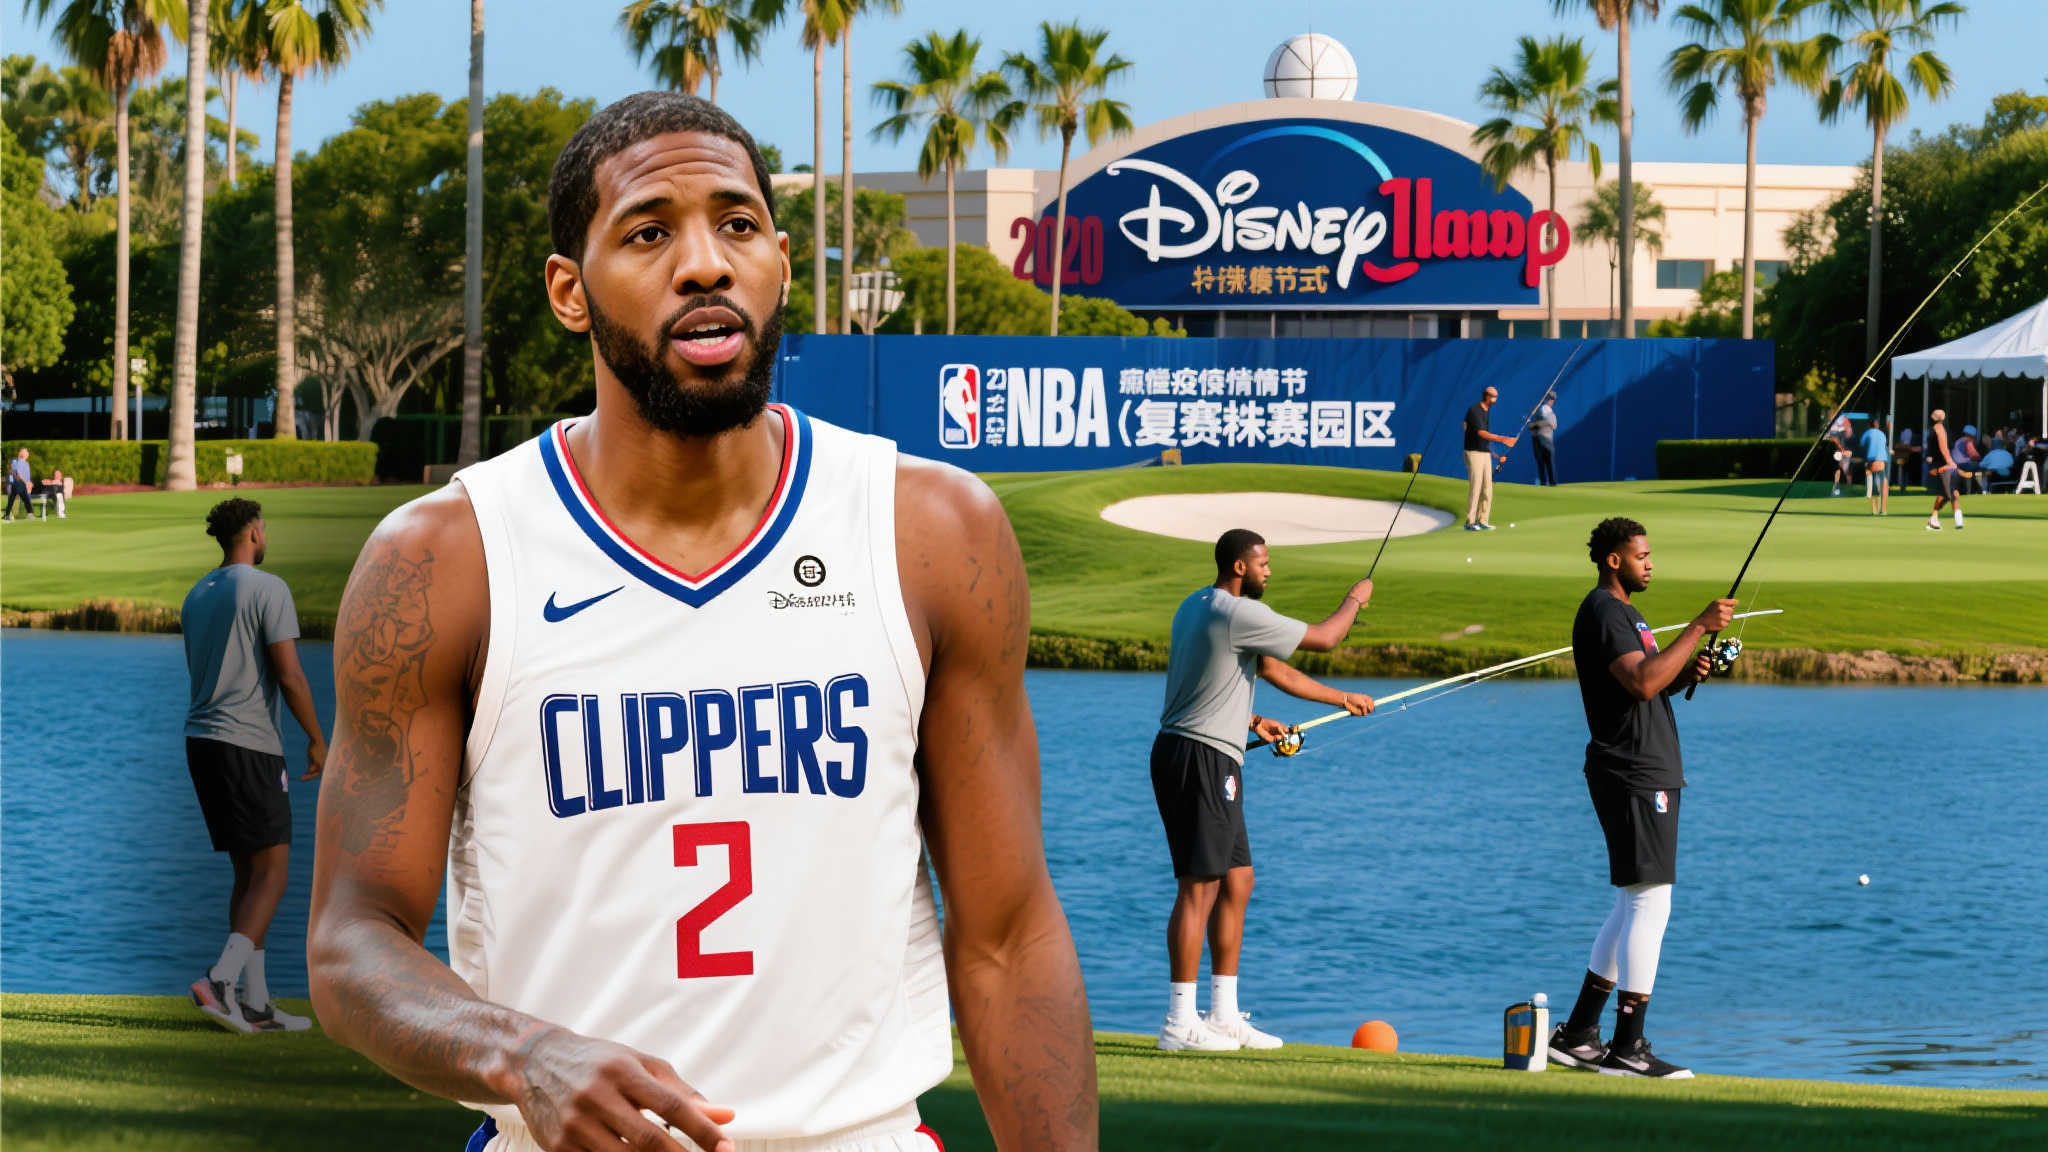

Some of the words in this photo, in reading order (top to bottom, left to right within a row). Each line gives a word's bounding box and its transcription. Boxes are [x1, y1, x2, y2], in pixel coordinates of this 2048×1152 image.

[1009, 215, 1104, 286] 2020
[1006, 367, 1111, 447] NBA
[539, 672, 870, 819] CLIPPERS
[672, 820, 754, 979] 2
